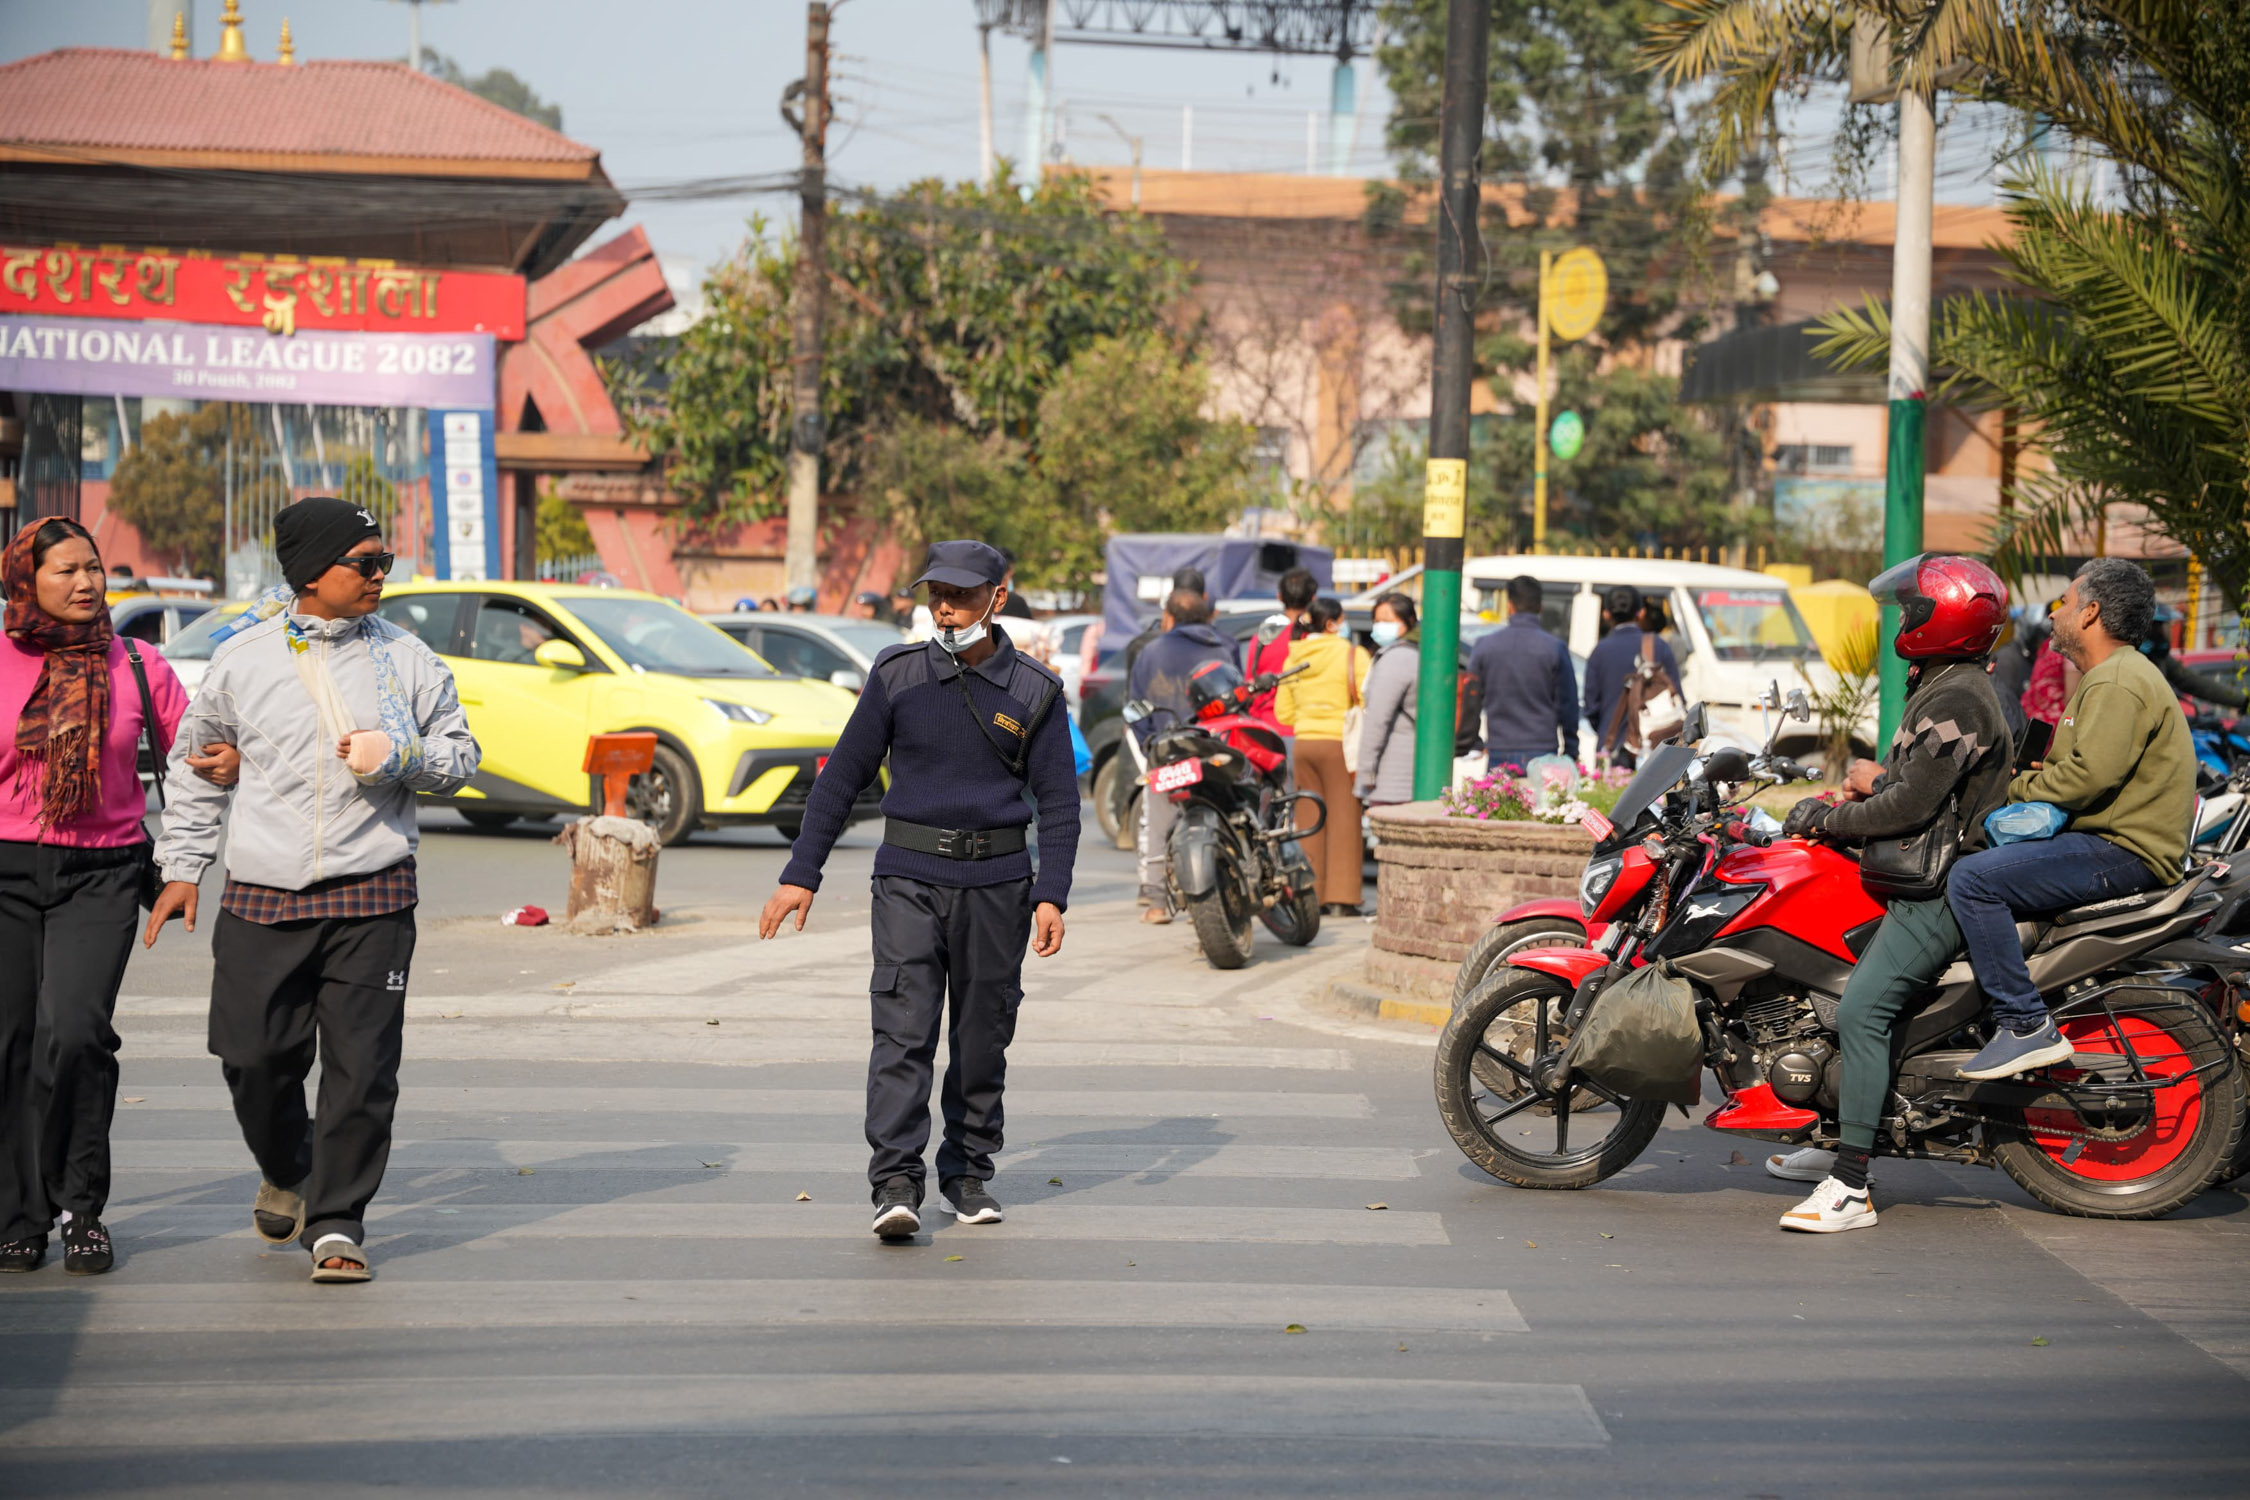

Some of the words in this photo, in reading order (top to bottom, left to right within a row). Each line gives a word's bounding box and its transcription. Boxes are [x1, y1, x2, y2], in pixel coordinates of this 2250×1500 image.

[3, 249, 180, 306] दशरथ
[205, 335, 366, 375] LEAGUE
[376, 342, 477, 376] 2082
[1790, 1073, 1812, 1083] TVS
